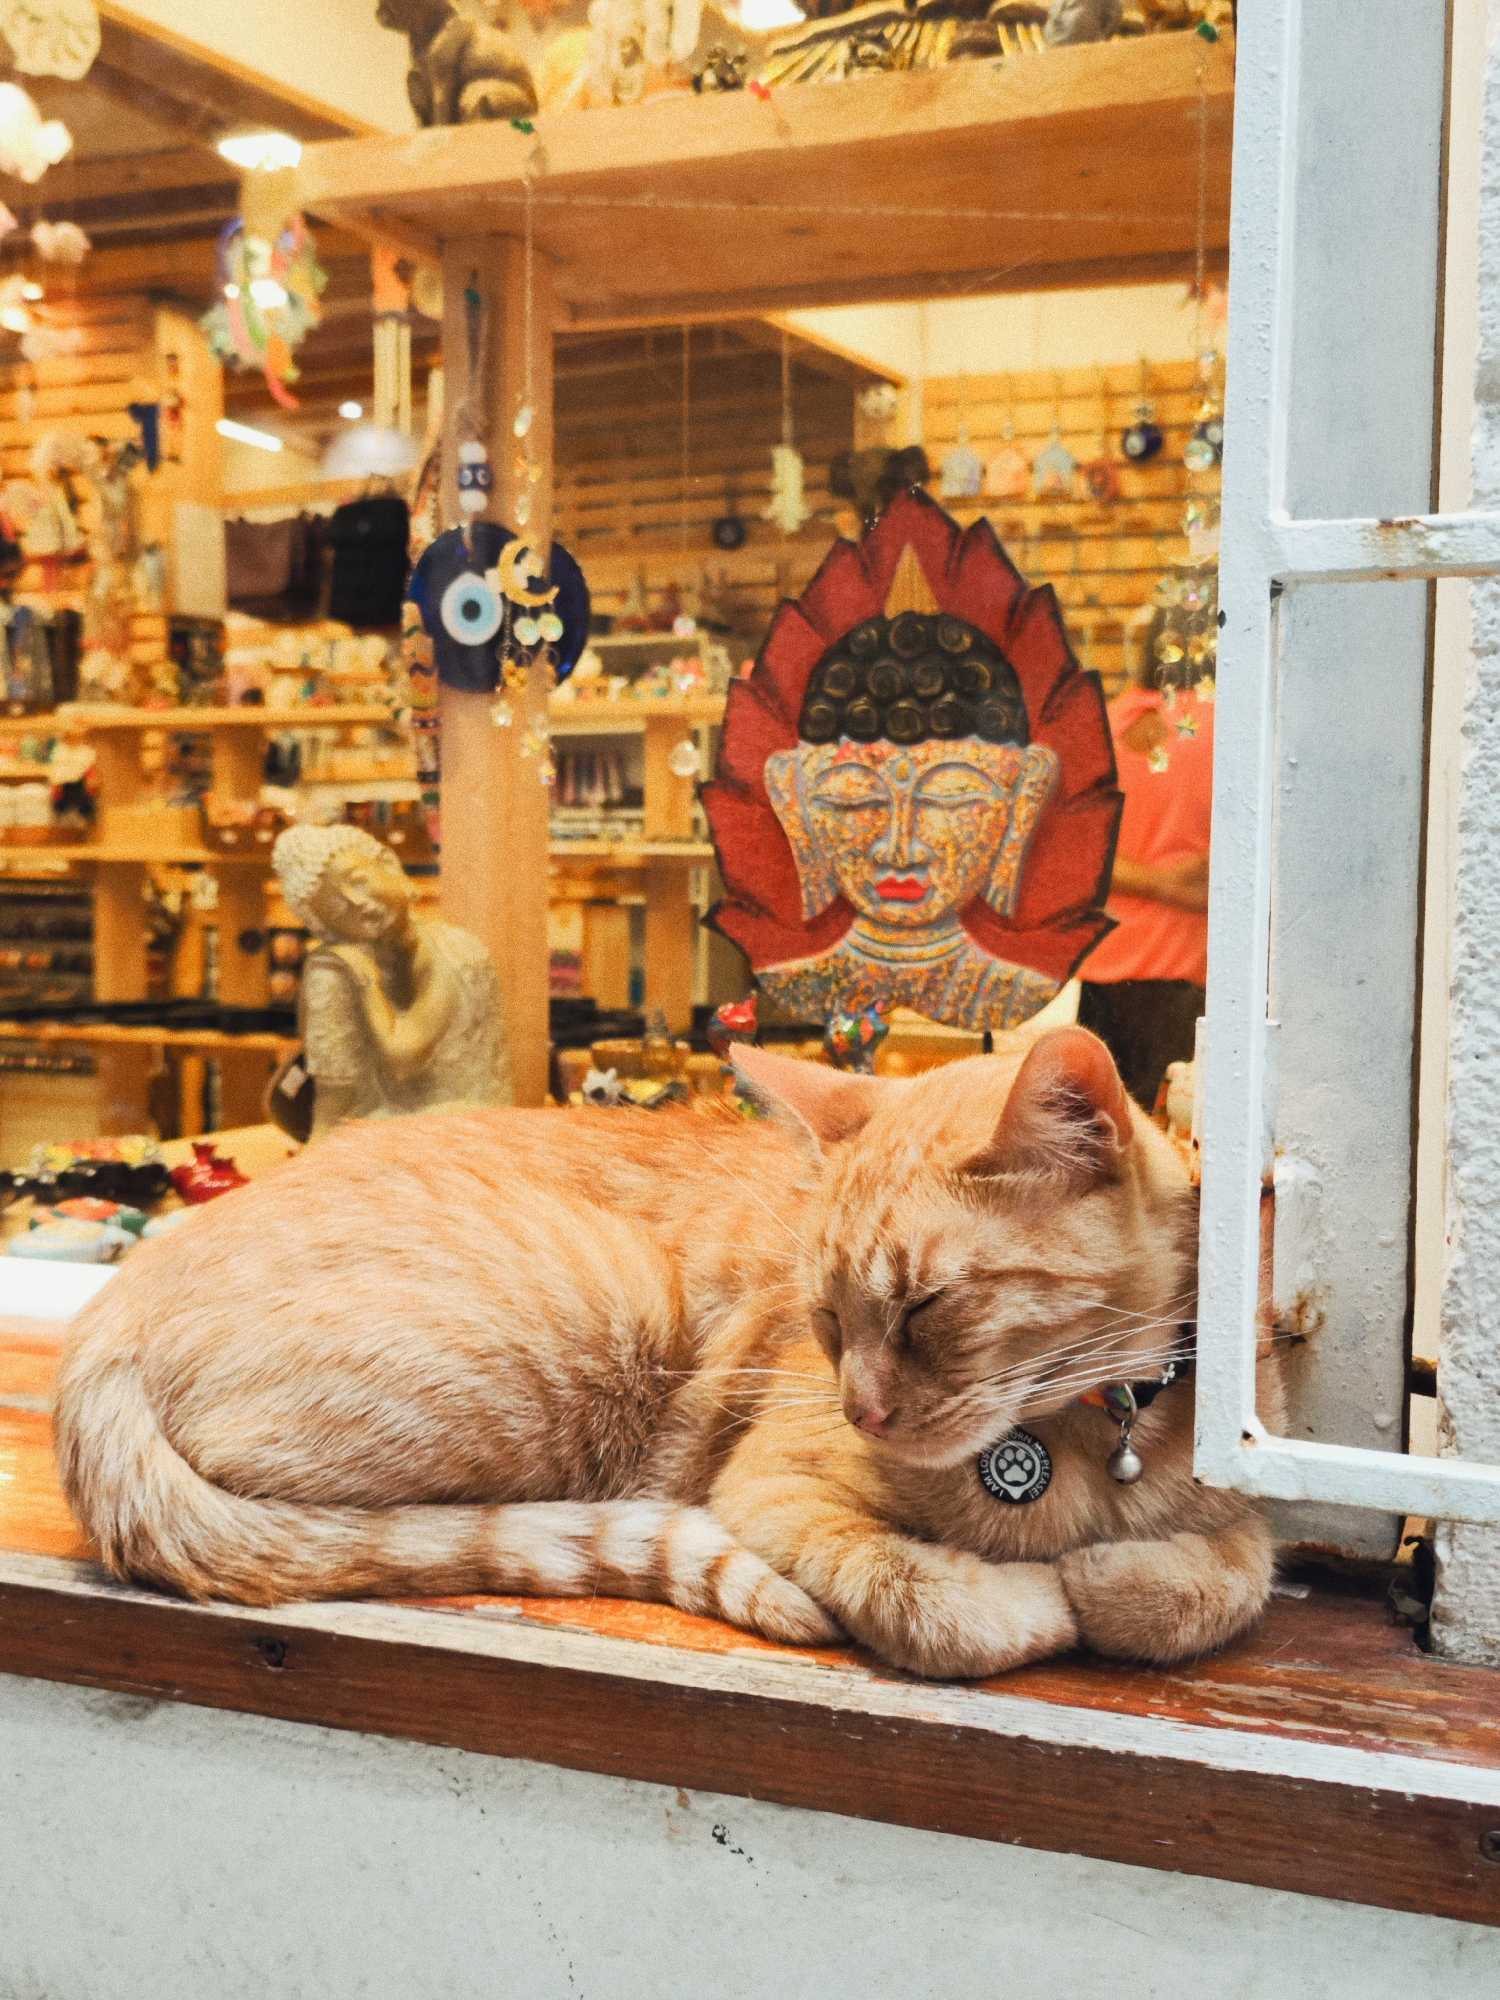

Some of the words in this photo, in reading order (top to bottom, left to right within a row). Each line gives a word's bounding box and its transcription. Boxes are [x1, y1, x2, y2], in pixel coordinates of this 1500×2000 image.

[1032, 1441, 1047, 1459] ME
[984, 1477, 999, 1492] AM
[1028, 1459, 1050, 1499] PLEASE!
[999, 1489, 1004, 1497] I
